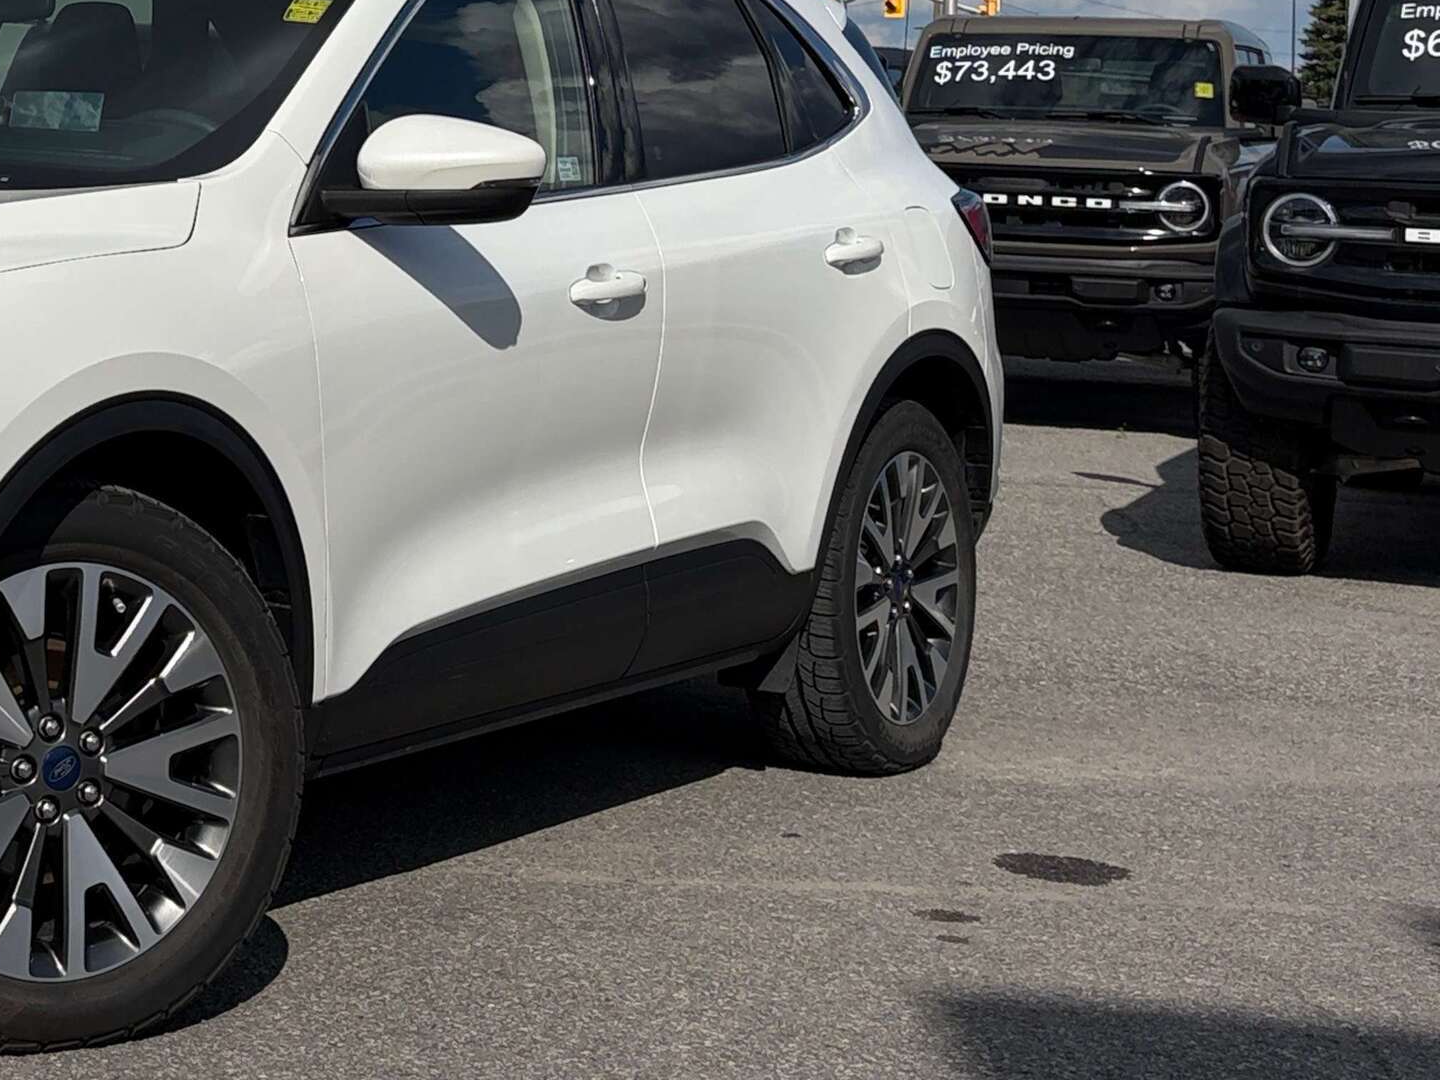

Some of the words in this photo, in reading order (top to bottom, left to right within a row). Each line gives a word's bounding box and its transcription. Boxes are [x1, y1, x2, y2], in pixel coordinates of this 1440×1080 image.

[930, 44, 1011, 59] Employee
[1016, 42, 1075, 59] Pricing
[934, 59, 1055, 85] $73,443
[982, 193, 1112, 208] ONCO
